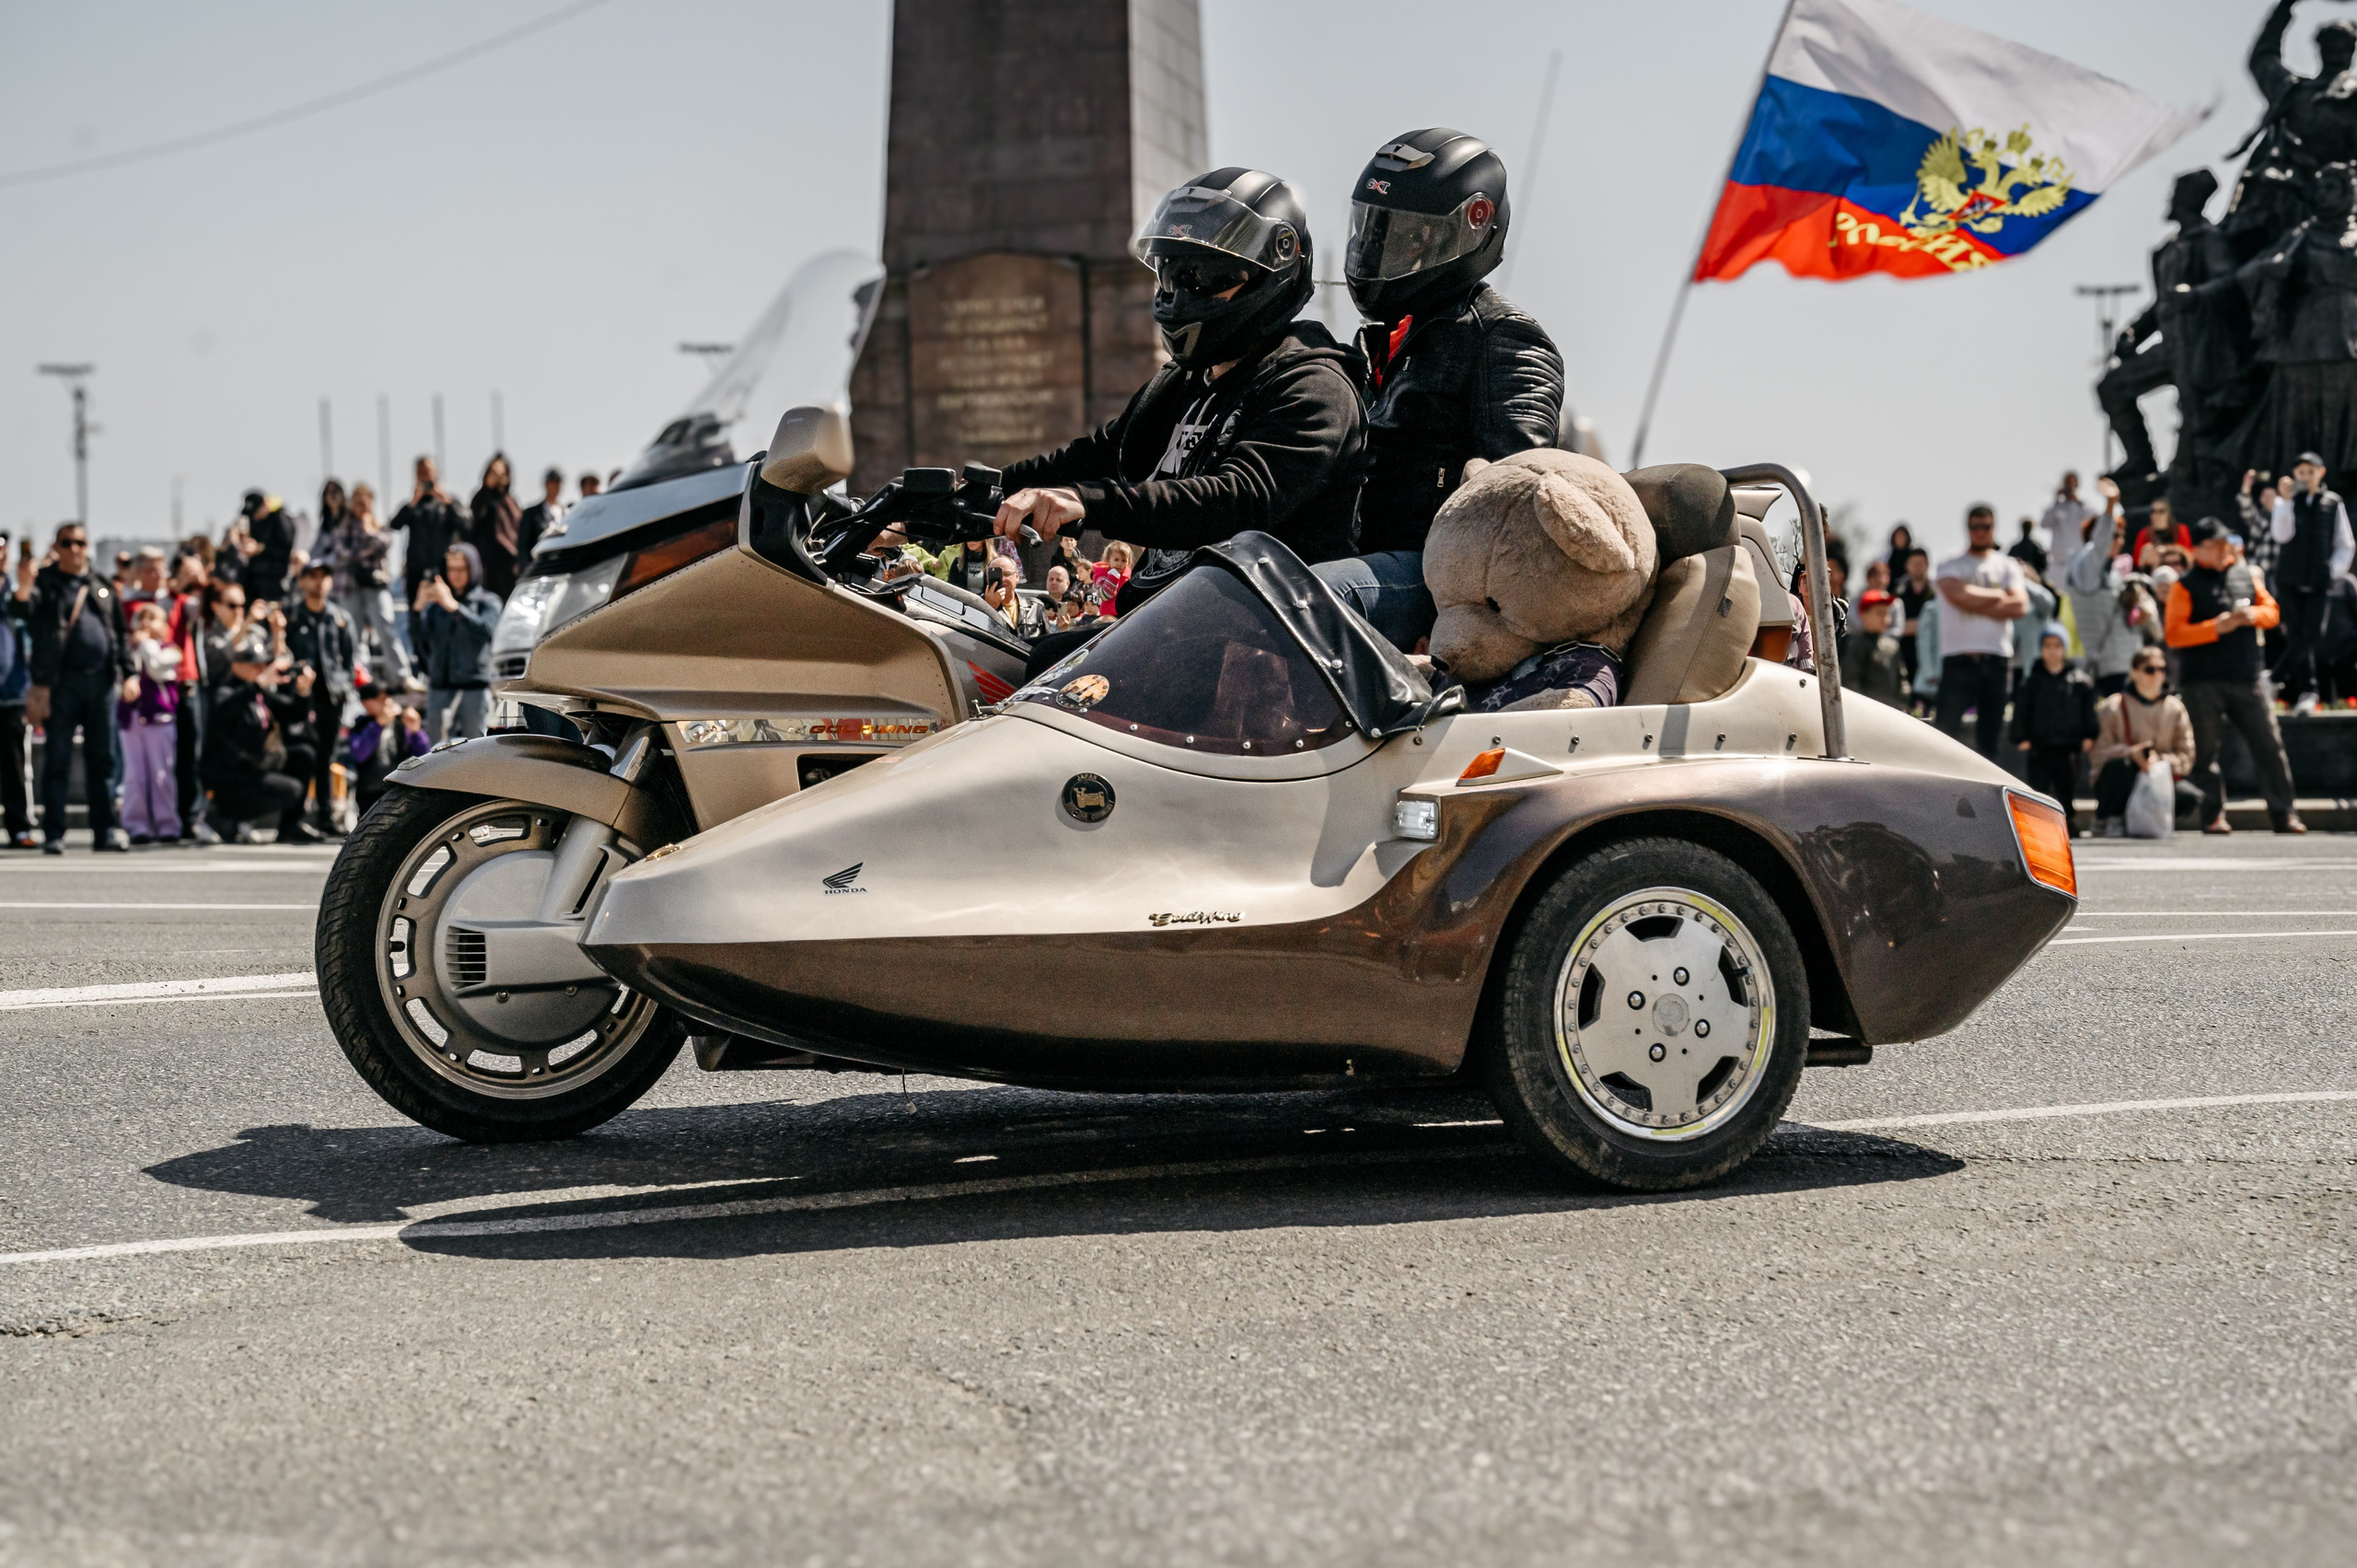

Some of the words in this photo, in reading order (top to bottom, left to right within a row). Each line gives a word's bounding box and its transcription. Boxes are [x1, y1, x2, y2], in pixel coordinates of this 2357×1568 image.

[1366, 178, 1390, 193] GXT
[1167, 224, 1192, 238] GXT
[824, 887, 868, 895] HONDA
